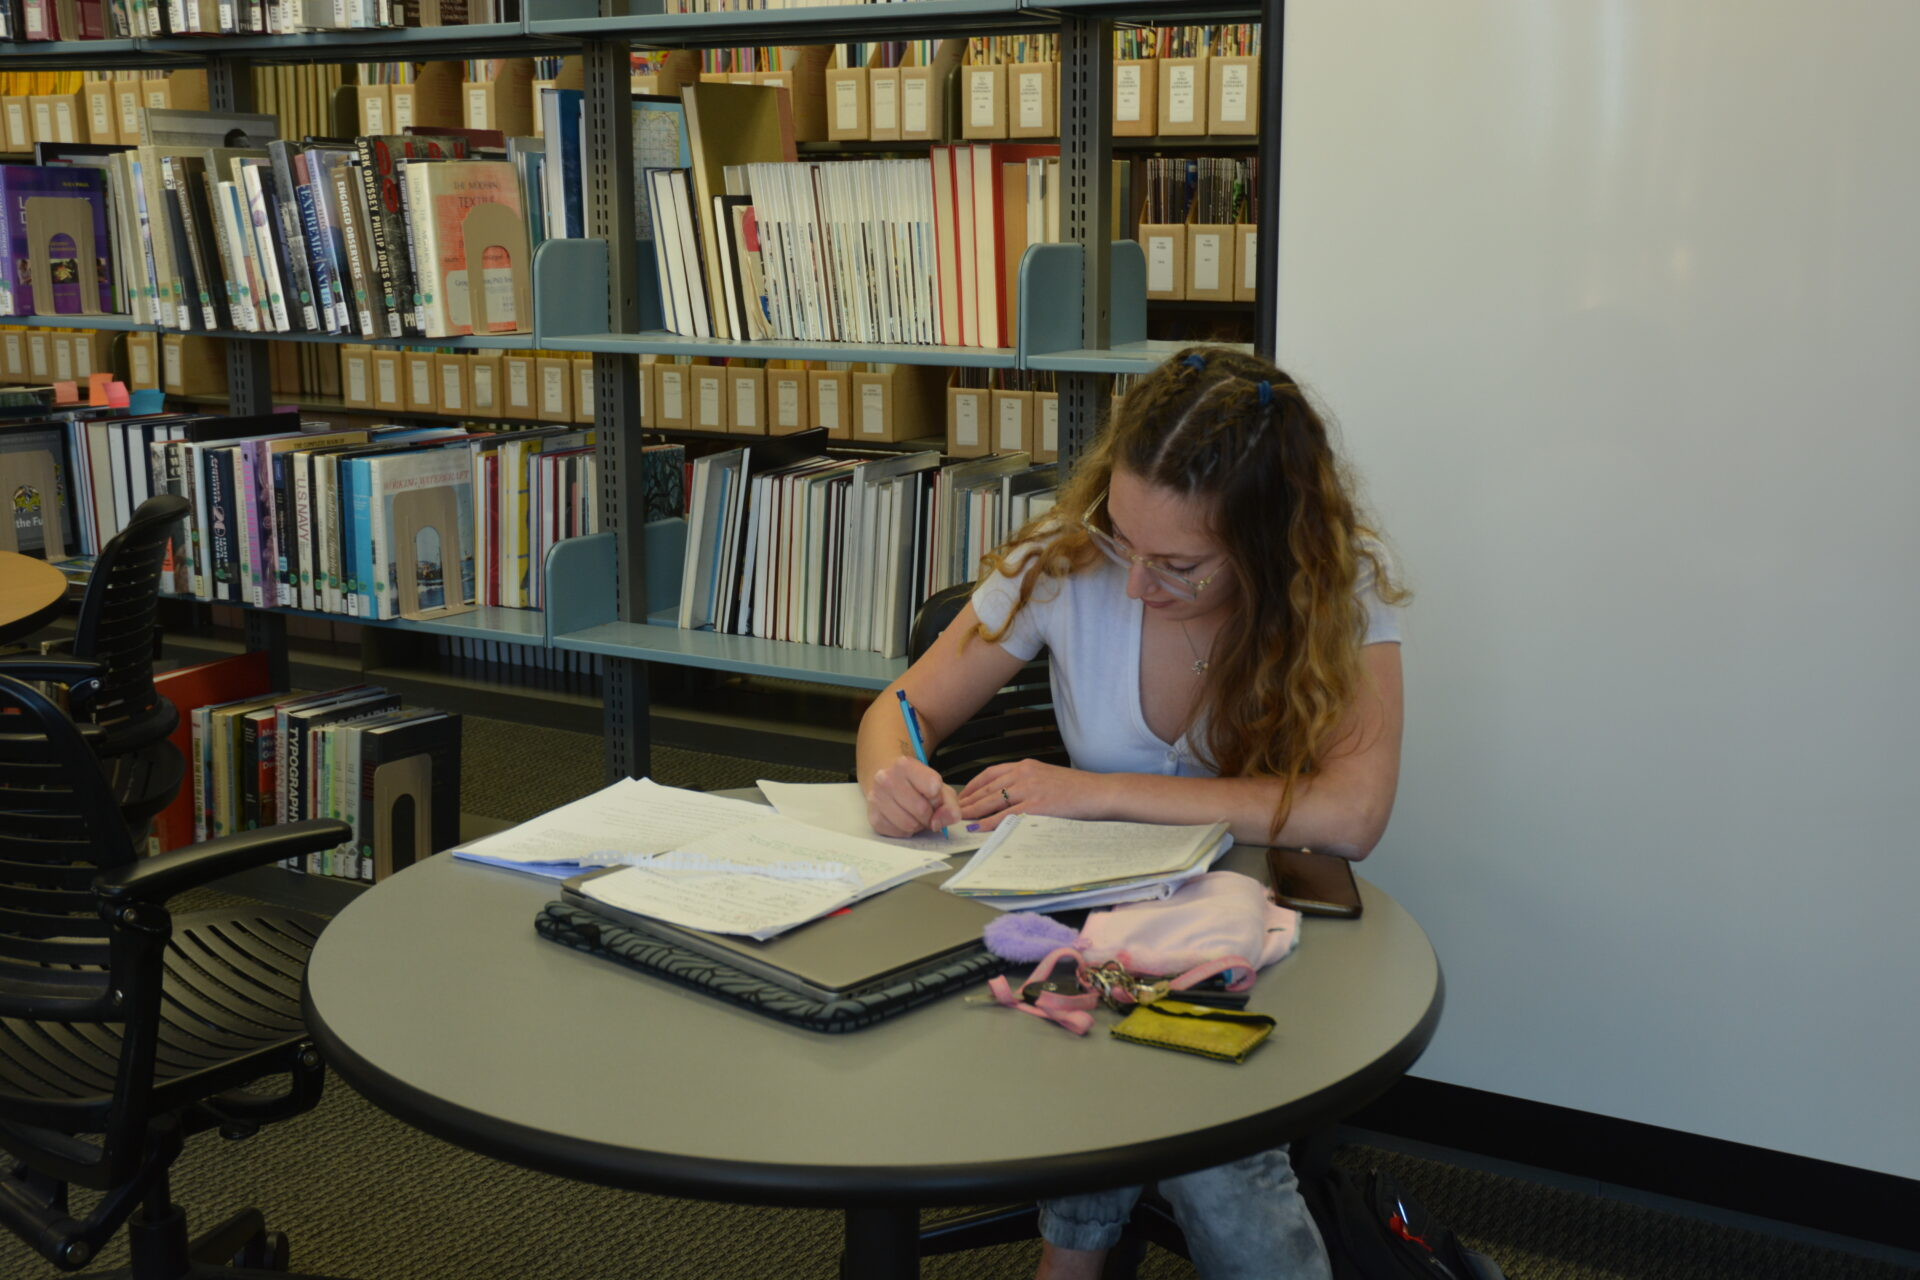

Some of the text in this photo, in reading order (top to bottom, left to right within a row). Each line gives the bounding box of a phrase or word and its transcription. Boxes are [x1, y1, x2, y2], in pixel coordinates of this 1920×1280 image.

[357, 141, 370, 167] DARK
[362, 168, 378, 211] ODYSSEY
[336, 180, 362, 279] ENGAGED OBSERVERS
[371, 214, 385, 247] PHILIP
[377, 249, 391, 279] JONES
[16, 518, 31, 528] the
[297, 503, 309, 541] NAVY
[276, 733, 287, 824] HUMAN BRAI
[288, 726, 299, 823] TYPOGRAPHY
